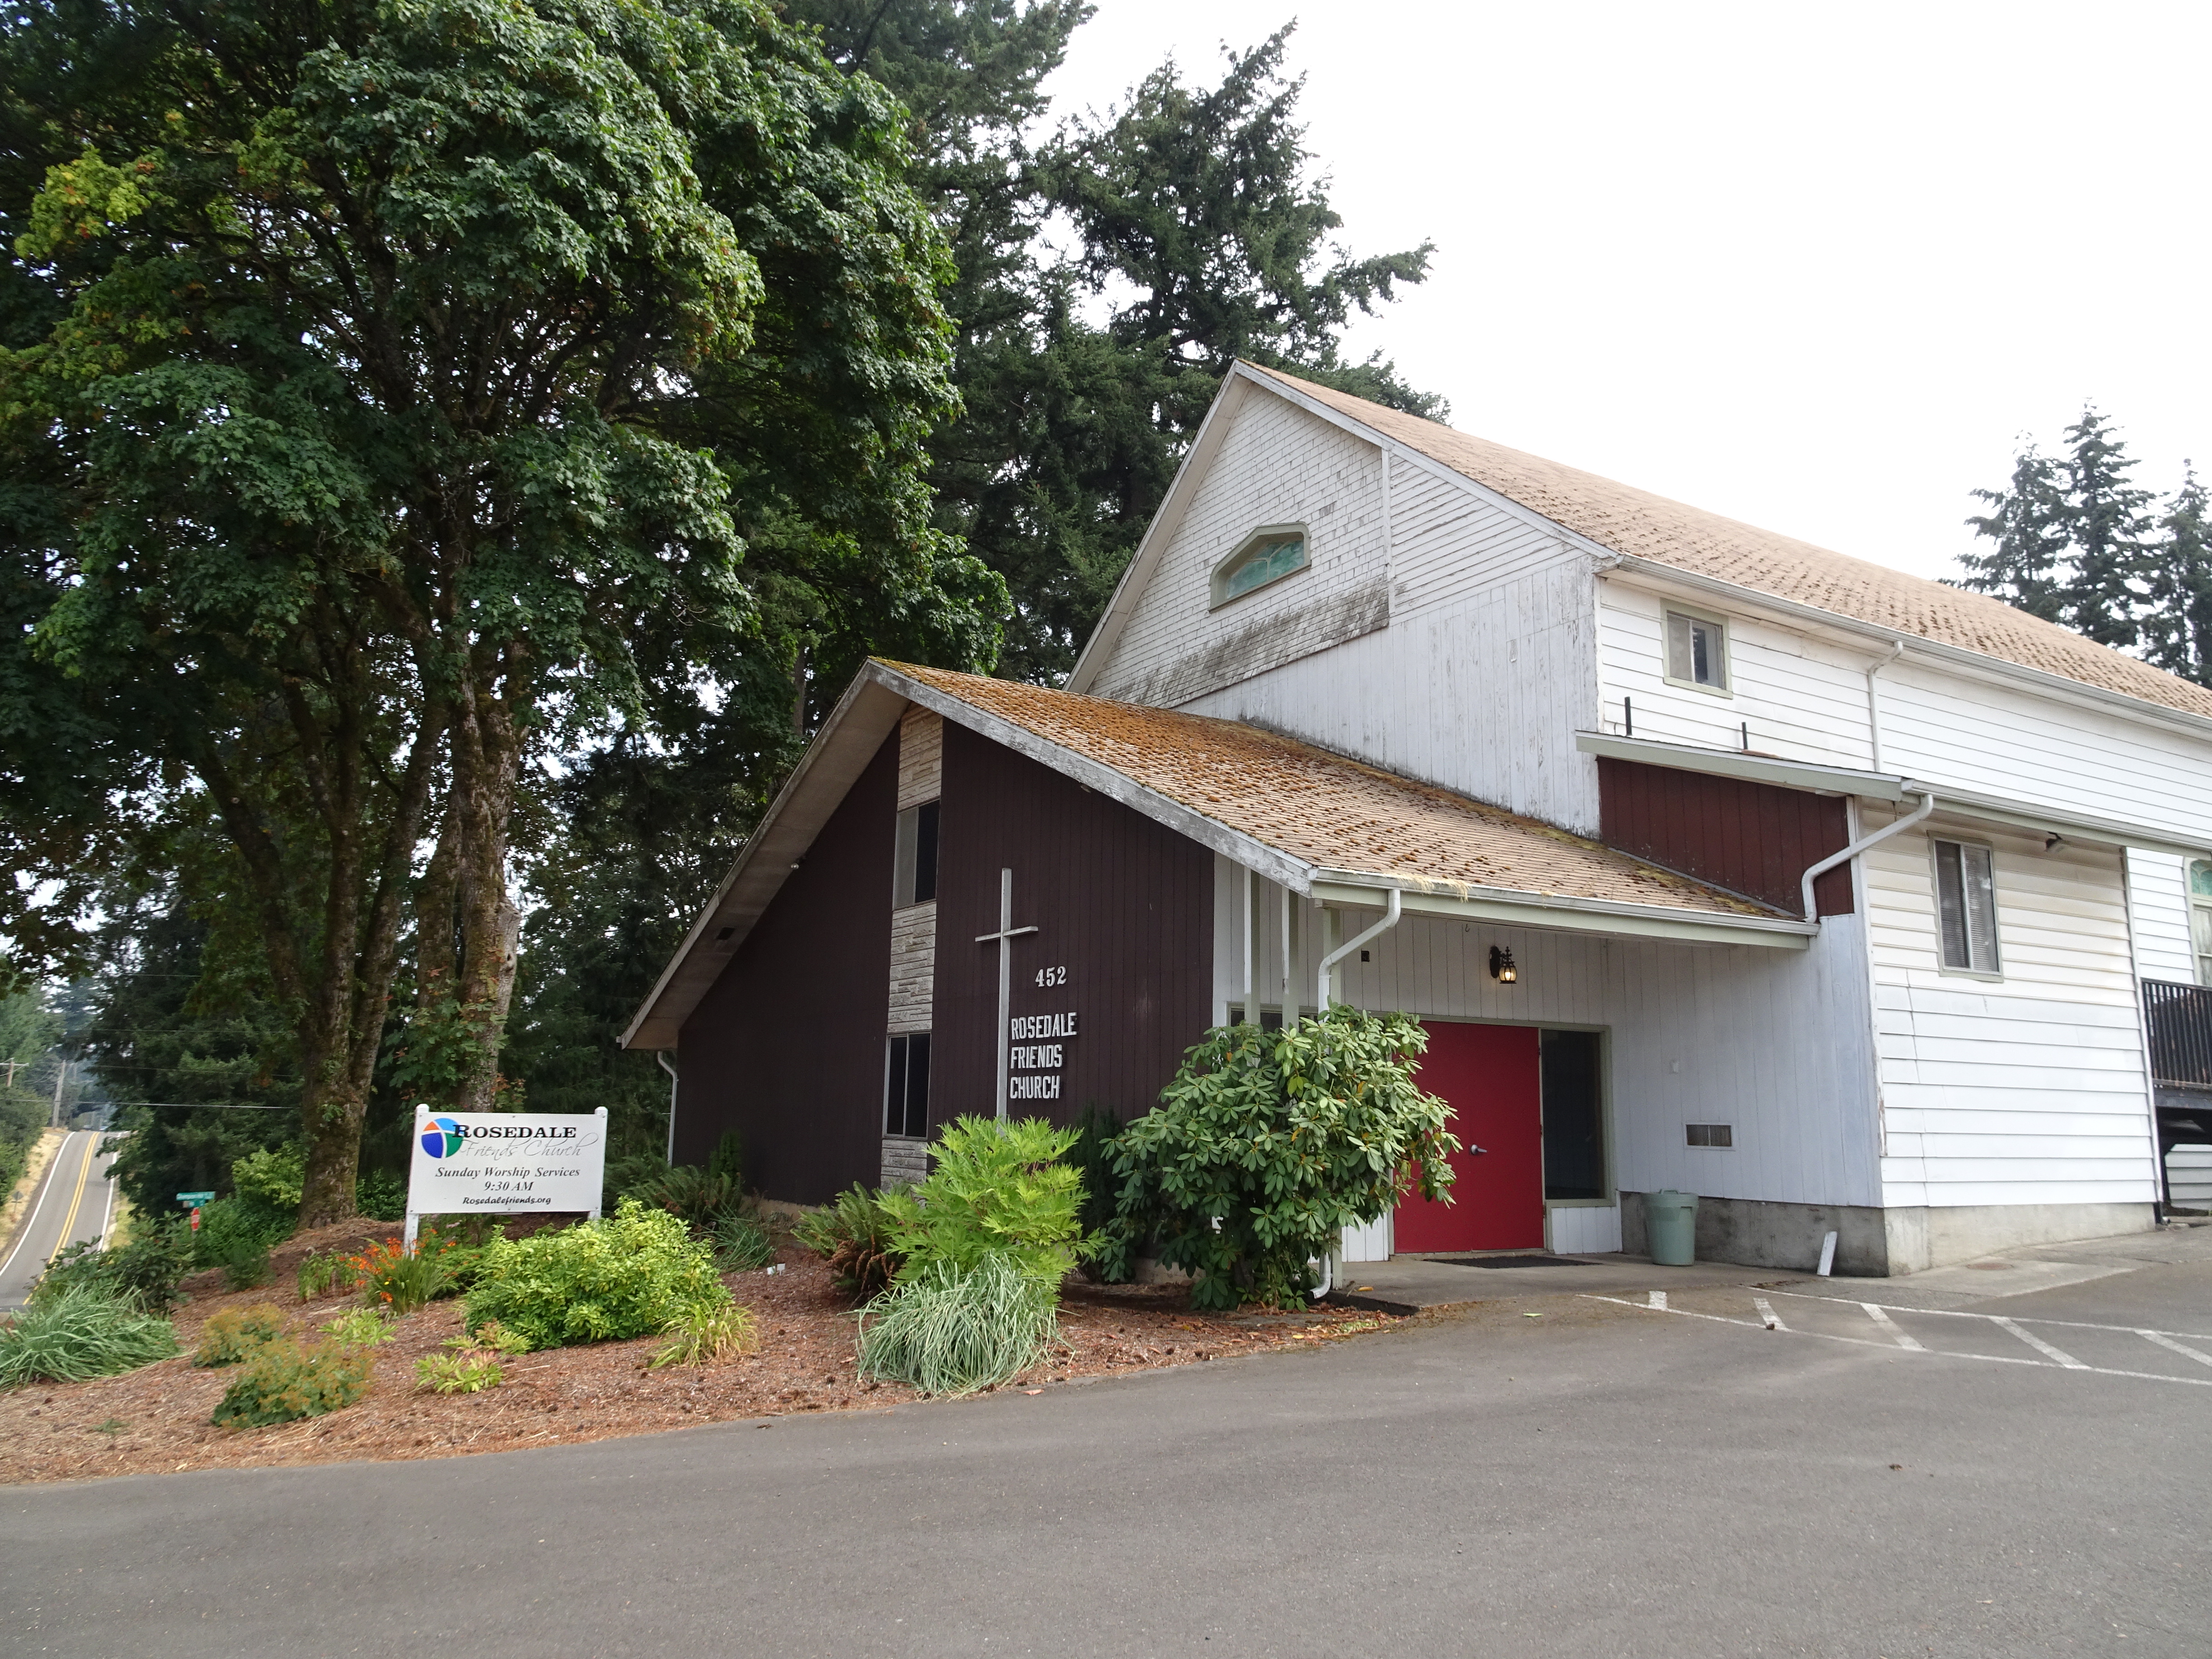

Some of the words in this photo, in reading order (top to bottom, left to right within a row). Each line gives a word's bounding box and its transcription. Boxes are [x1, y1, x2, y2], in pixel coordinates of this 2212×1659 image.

[1035, 965, 1067, 987] 452
[1011, 1012, 1077, 1040] ROSEDALE
[1010, 1044, 1063, 1069] FRIENDS
[1010, 1075, 1060, 1099] CHURCH
[452, 1124, 576, 1138] ROSEDALE
[459, 1137, 531, 1161] Friends
[524, 1132, 599, 1157] Church
[435, 1167, 481, 1179] Sunday
[484, 1167, 530, 1179] Worship
[534, 1167, 580, 1177] Services
[483, 1181, 510, 1191] 9:30
[511, 1181, 534, 1191] AM
[463, 1196, 551, 1205] Rosedalefriends.org
